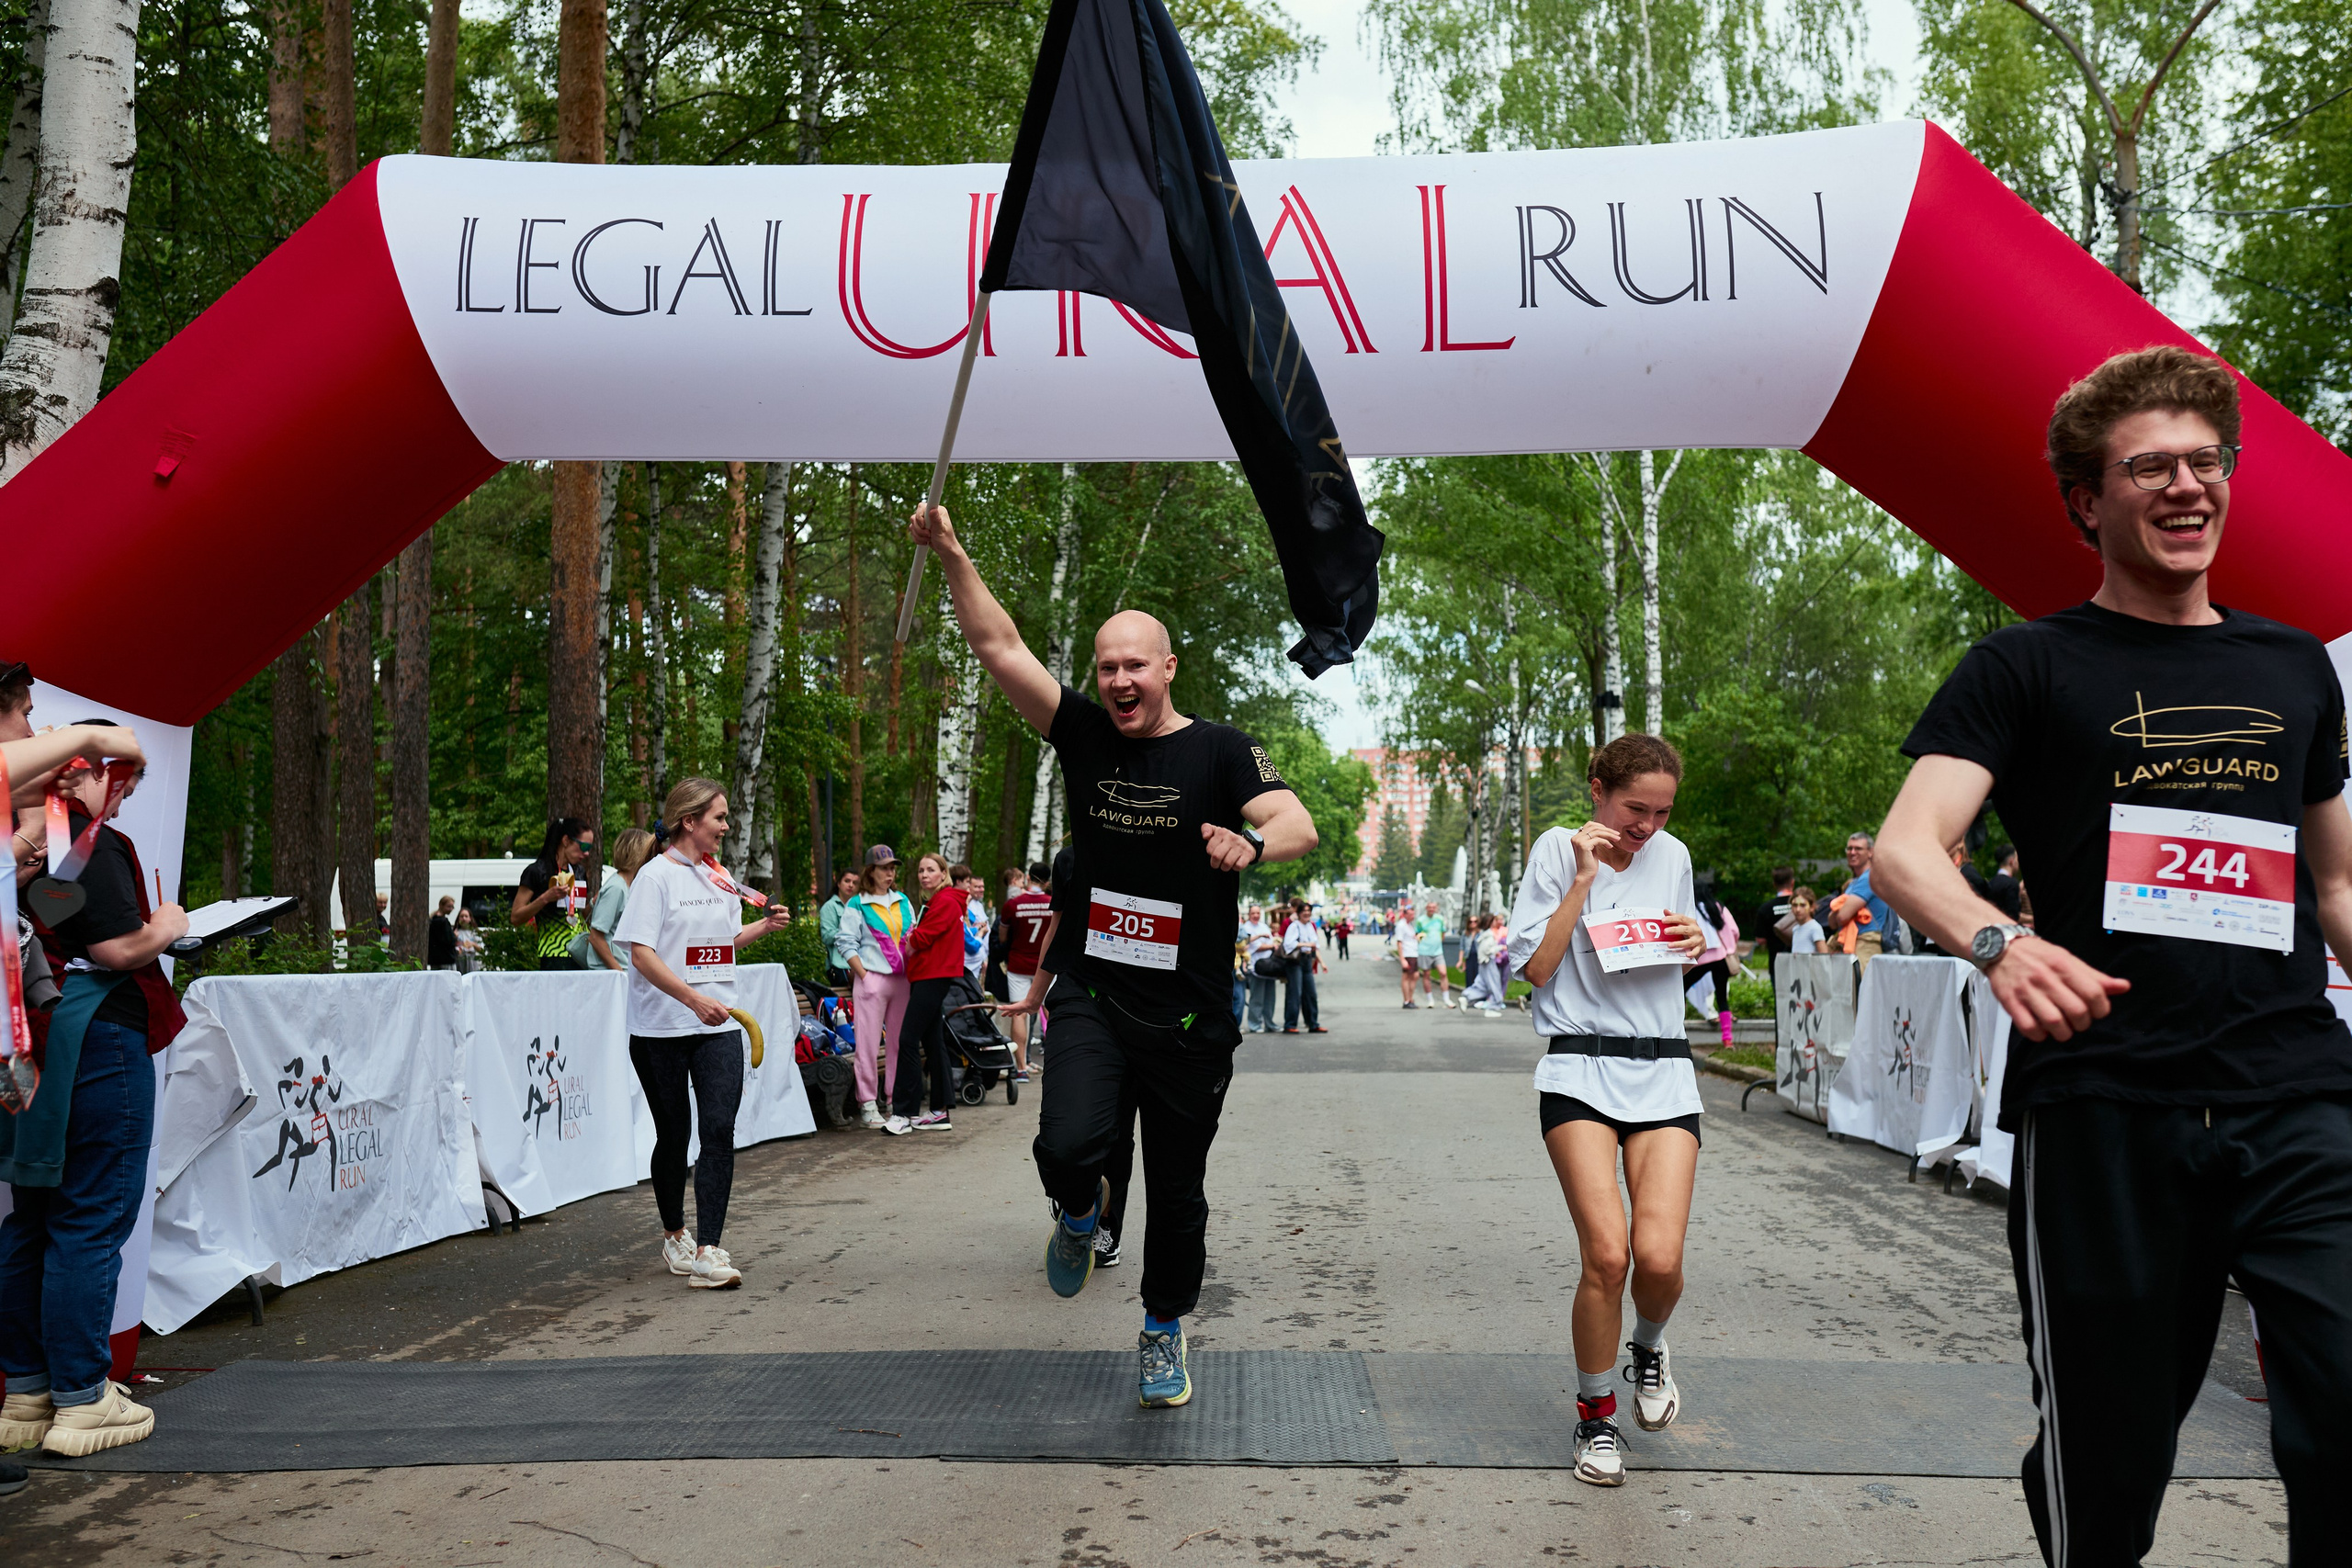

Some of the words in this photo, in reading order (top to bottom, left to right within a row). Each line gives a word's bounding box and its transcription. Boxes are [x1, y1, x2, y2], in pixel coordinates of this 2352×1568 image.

[455, 216, 813, 317] LEGAL
[1514, 190, 1828, 309] RUN
[2114, 757, 2280, 788] LAWGUARD
[2211, 781, 2245, 793] группа
[1089, 805, 1179, 828] LAWGUARD
[2155, 843, 2250, 888] 244
[679, 898, 706, 908] DANCING
[706, 897, 725, 907] QUEEN
[1027, 918, 1043, 943] 7
[1108, 910, 1155, 938] 205
[1613, 921, 1662, 942] 219
[697, 947, 722, 964] 223
[563, 1074, 584, 1095] URAL
[338, 1104, 374, 1131] URAL
[563, 1092, 593, 1121] LEGAL
[563, 1121, 582, 1140] RUN
[338, 1127, 384, 1166] LEGAL
[339, 1164, 366, 1190] RUN
